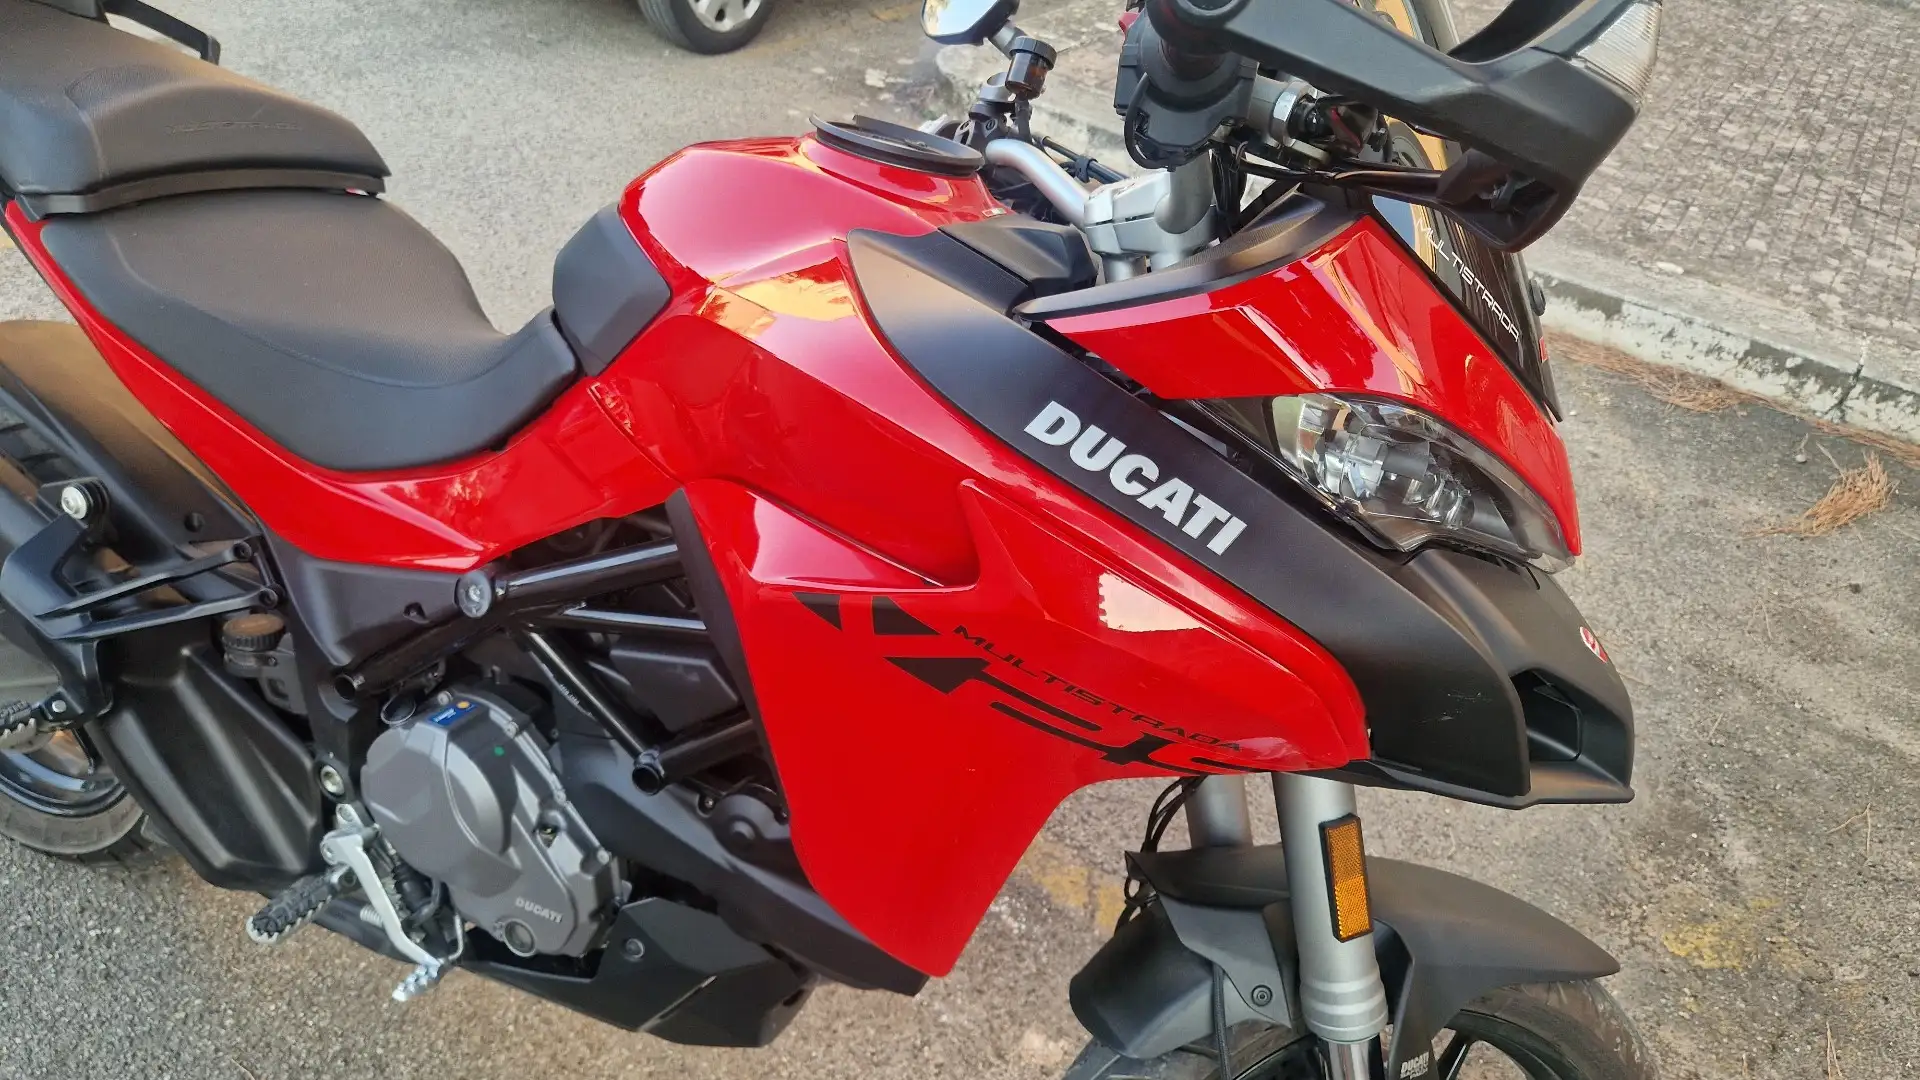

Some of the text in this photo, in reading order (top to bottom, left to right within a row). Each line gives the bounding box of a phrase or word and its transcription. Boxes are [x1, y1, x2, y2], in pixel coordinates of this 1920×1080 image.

[1416, 219, 1520, 342] MULTISTRADA
[1023, 400, 1248, 556] DUCATI
[953, 624, 1240, 751] MULTISTRADA
[515, 896, 563, 923] DUCATI
